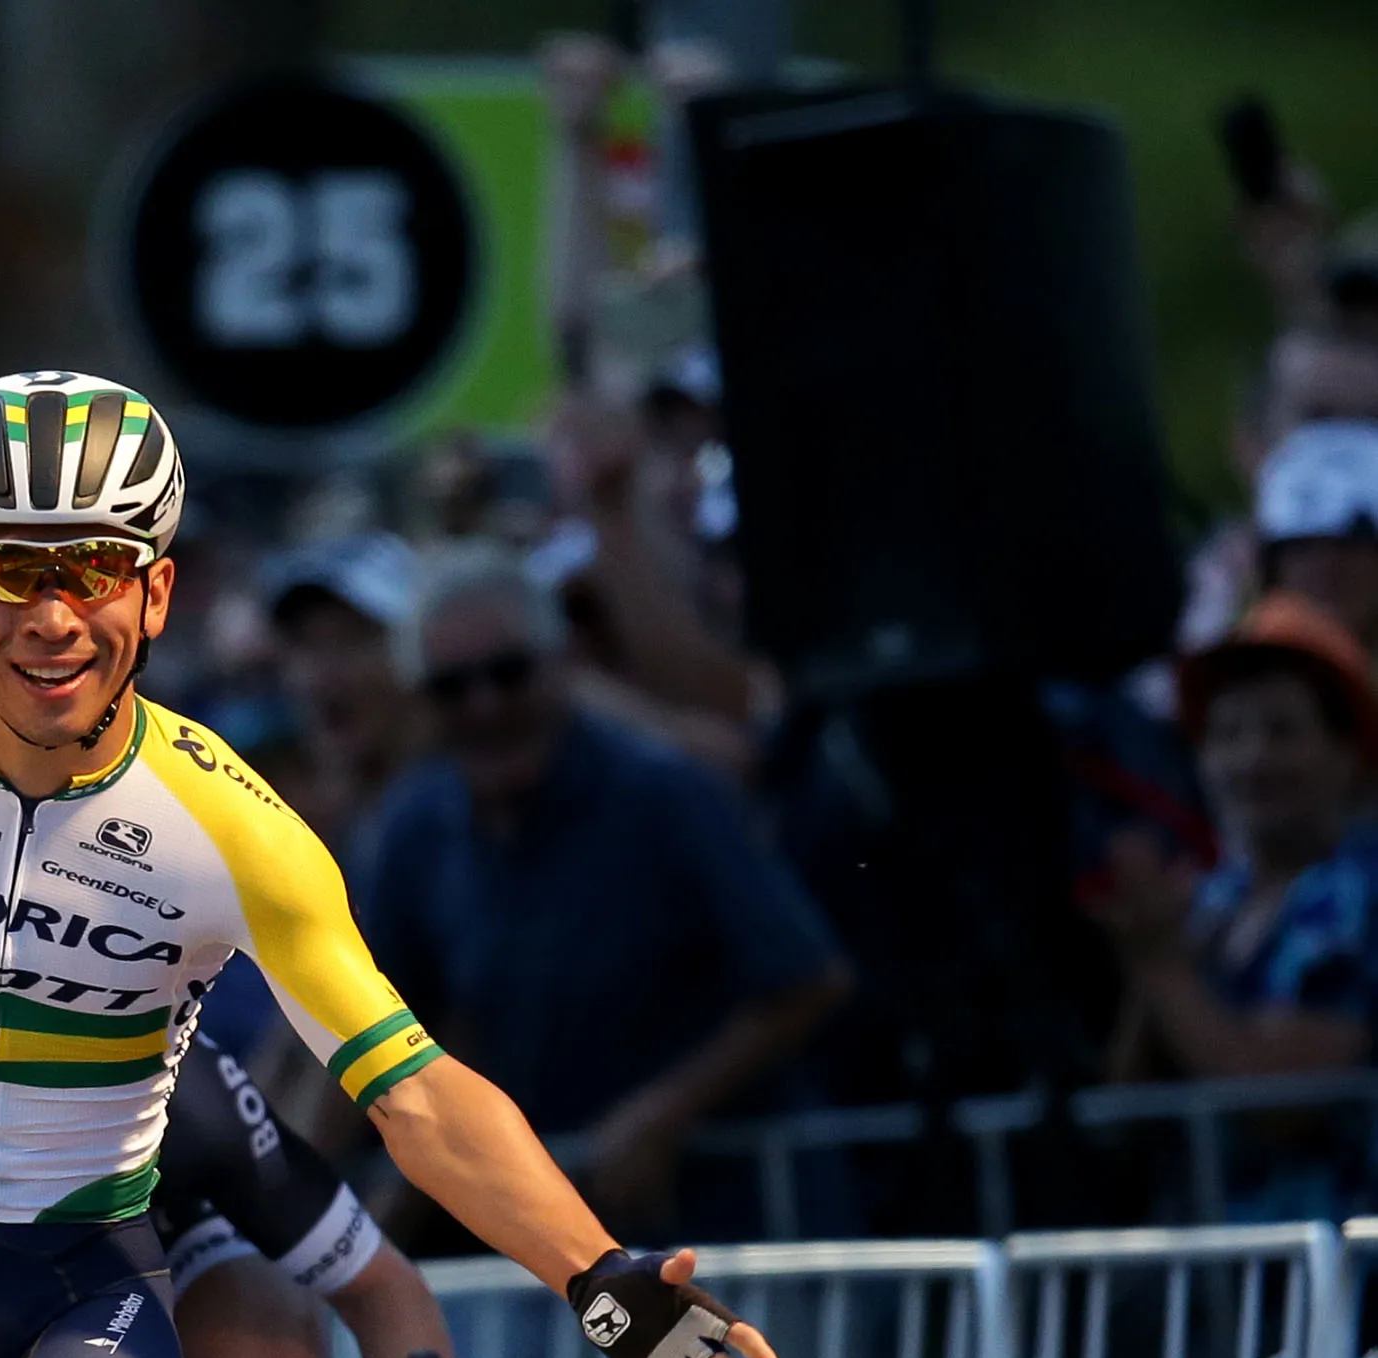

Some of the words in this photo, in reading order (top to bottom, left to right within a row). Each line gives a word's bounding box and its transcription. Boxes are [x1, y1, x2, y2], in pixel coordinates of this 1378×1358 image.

[199, 170, 416, 346] 25
[40, 860, 159, 910] GreenEDGE
[196, 1029, 281, 1161] BOR
